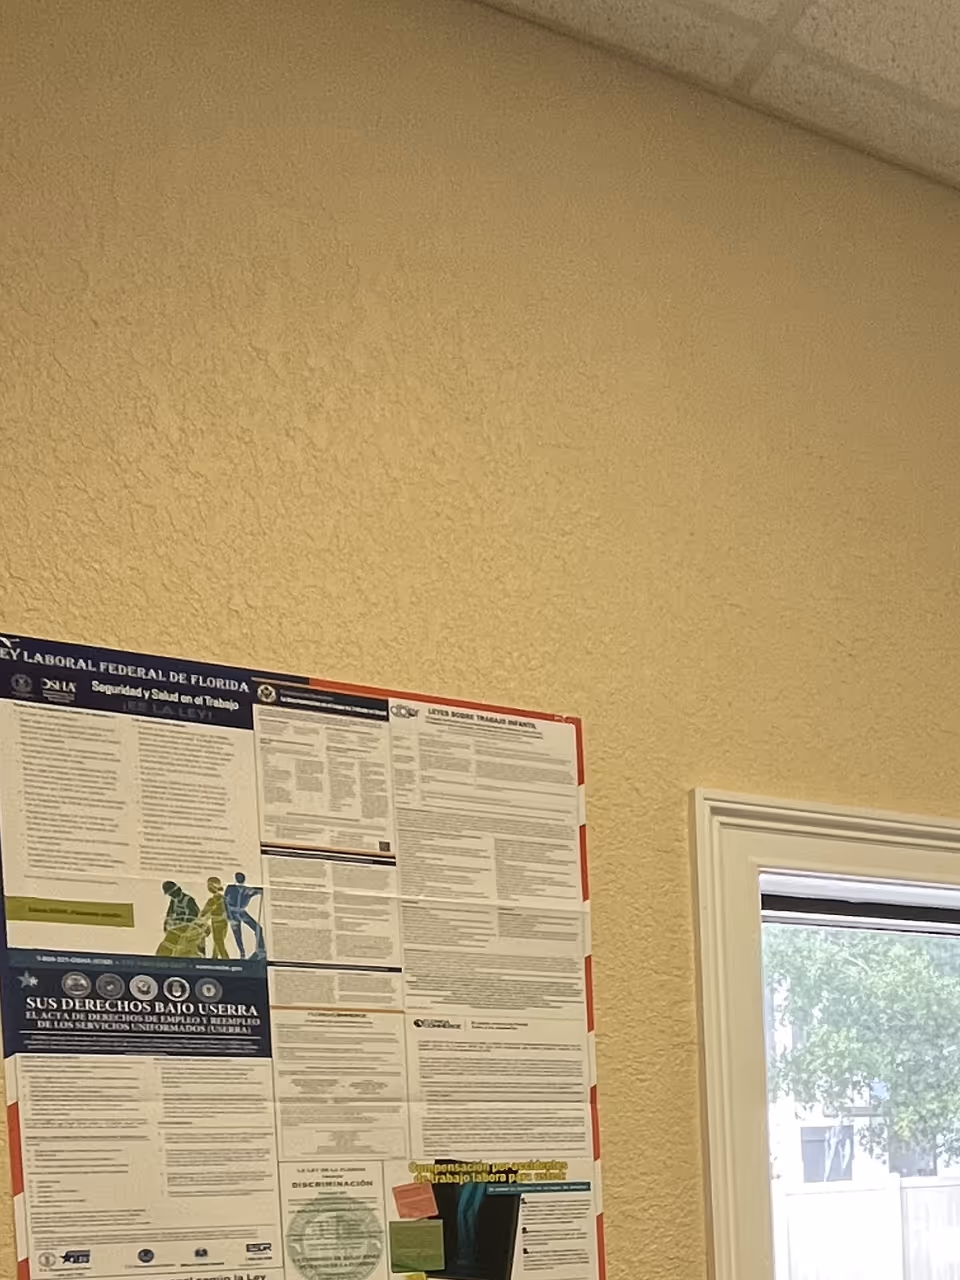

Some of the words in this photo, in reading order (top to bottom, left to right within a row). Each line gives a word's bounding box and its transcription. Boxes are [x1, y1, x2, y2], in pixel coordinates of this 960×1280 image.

[24, 651, 96, 671] LABORAL
[99, 661, 166, 681] FEDERAL
[170, 671, 187, 684] DE
[191, 674, 249, 693] FLORIDA
[92, 680, 142, 697] Seguridad
[143, 690, 150, 700] y
[151, 689, 179, 702] Salud
[180, 695, 192, 704] en
[204, 696, 239, 712] Trabajo
[26, 996, 57, 1009] SUS
[61, 998, 151, 1012] DERECHOS
[155, 1002, 194, 1015] BAJO
[198, 1003, 258, 1016] USERRA
[25, 1011, 39, 1020] EL
[41, 1011, 70, 1020] ACTA
[72, 1013, 87, 1021] DE
[88, 1013, 143, 1022] DERECHOS
[160, 1015, 201, 1024] EMPLEO
[201, 1016, 208, 1024] Y
[211, 1017, 260, 1026] REEMPLEO
[37, 1020, 54, 1028] DE
[54, 1021, 74, 1029] LOS
[75, 1021, 130, 1031] SERVICIOS
[131, 1023, 205, 1032] UNIFORMADOS
[408, 1159, 490, 1173] Compensación
[292, 1180, 374, 1189] DISCRIMINACIÓN
[432, 1172, 470, 1185] trabajo
[472, 1171, 507, 1183] labora
